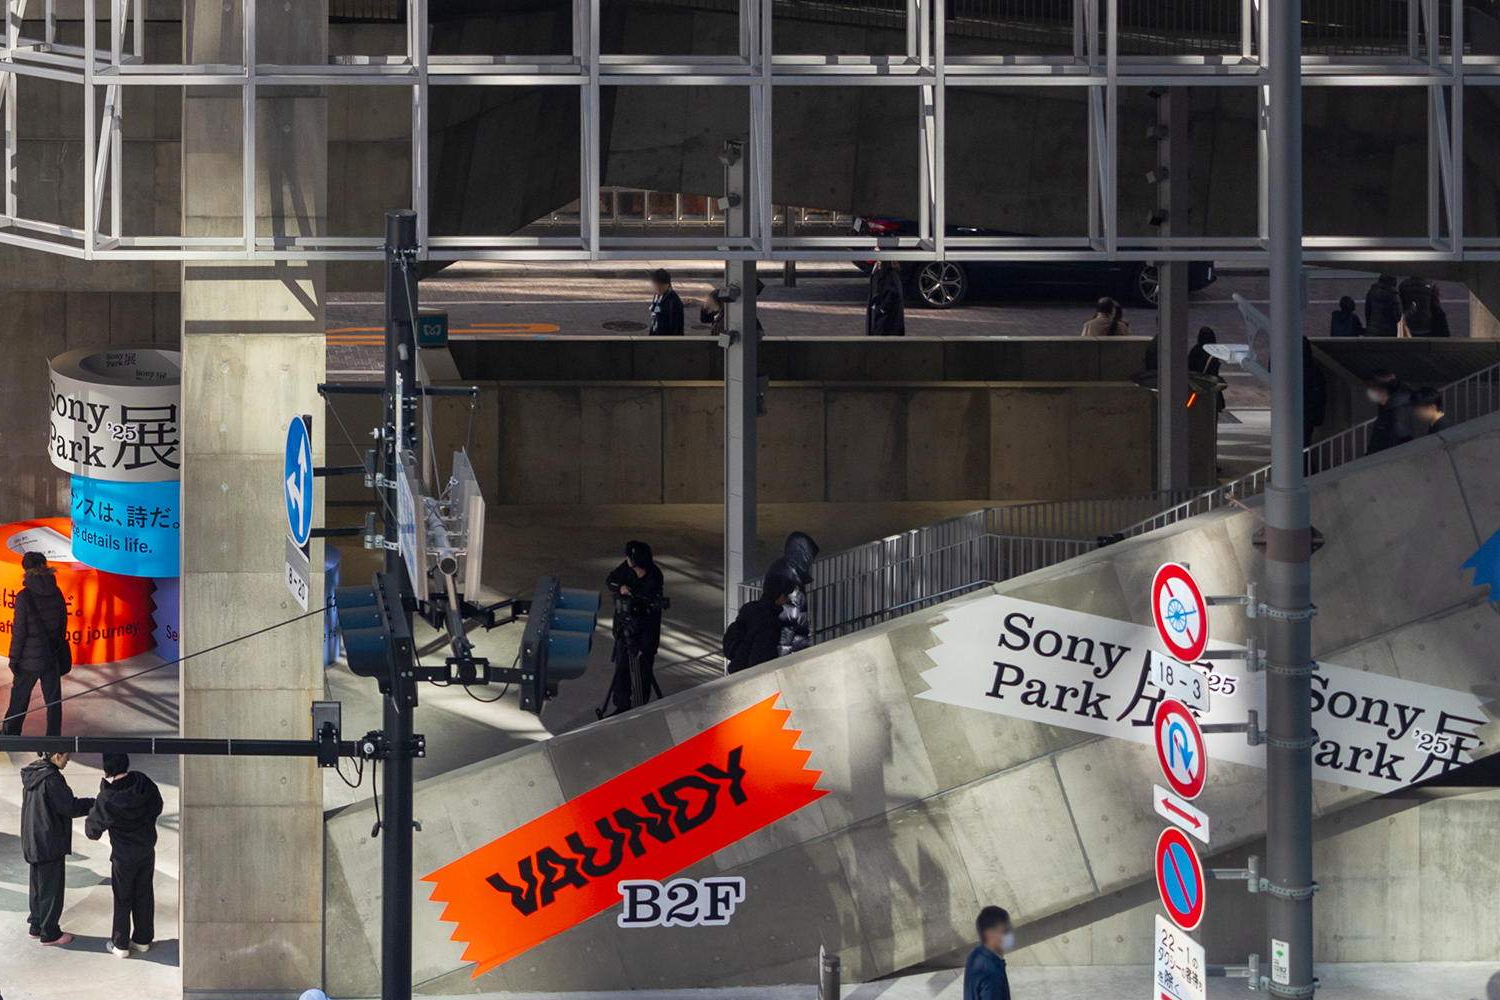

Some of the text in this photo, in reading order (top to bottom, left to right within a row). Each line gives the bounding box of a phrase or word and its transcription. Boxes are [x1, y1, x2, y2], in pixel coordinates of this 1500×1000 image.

[112, 402, 180, 471] 展
[81, 527, 121, 551] details
[124, 537, 153, 554] life.
[288, 567, 305, 601] 8-20
[997, 612, 1131, 679] Sony
[985, 661, 1111, 721] Park
[1313, 729, 1405, 783] ark
[485, 745, 748, 917] VAUNDY
[622, 881, 741, 923] B2F
